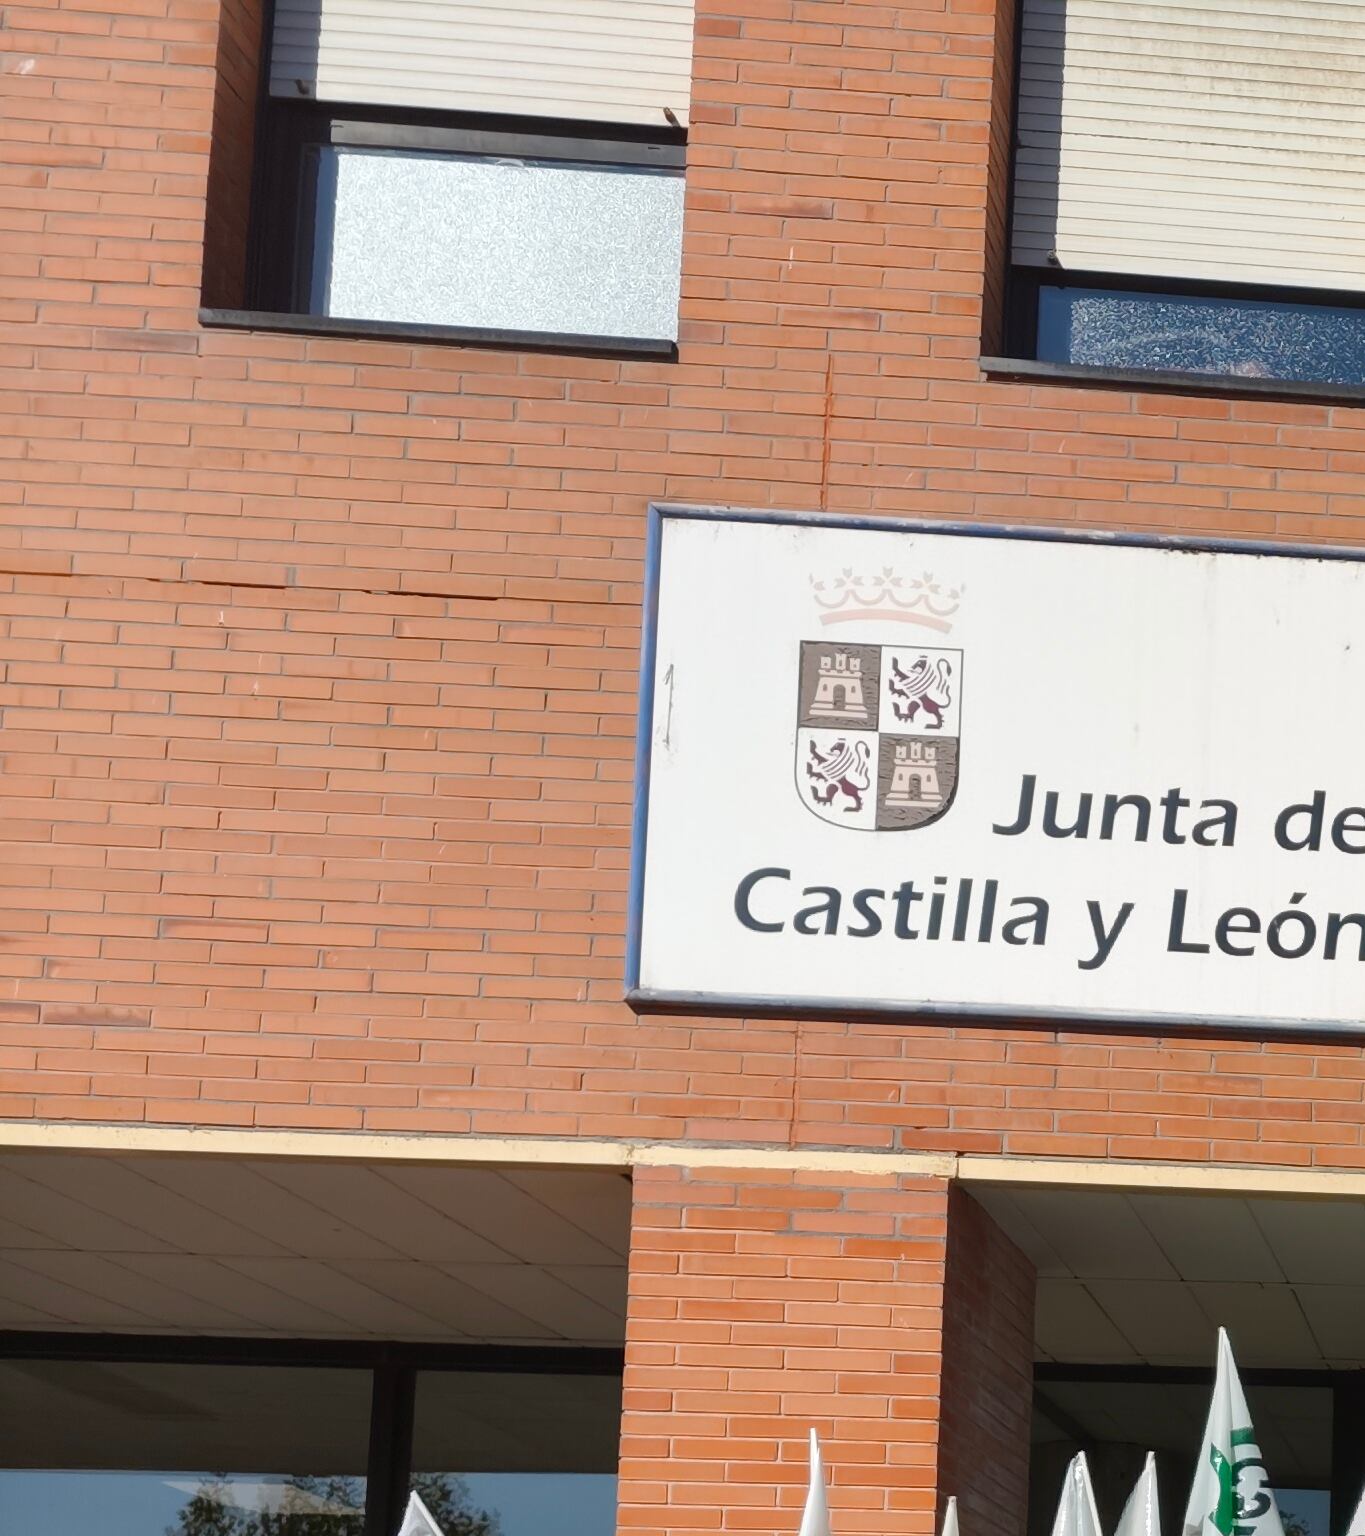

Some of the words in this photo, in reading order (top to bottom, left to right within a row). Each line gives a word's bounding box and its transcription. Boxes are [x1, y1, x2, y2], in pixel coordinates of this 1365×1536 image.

[991, 774, 1239, 847] Junta
[733, 866, 1050, 946] Castilla
[1077, 899, 1135, 970] y
